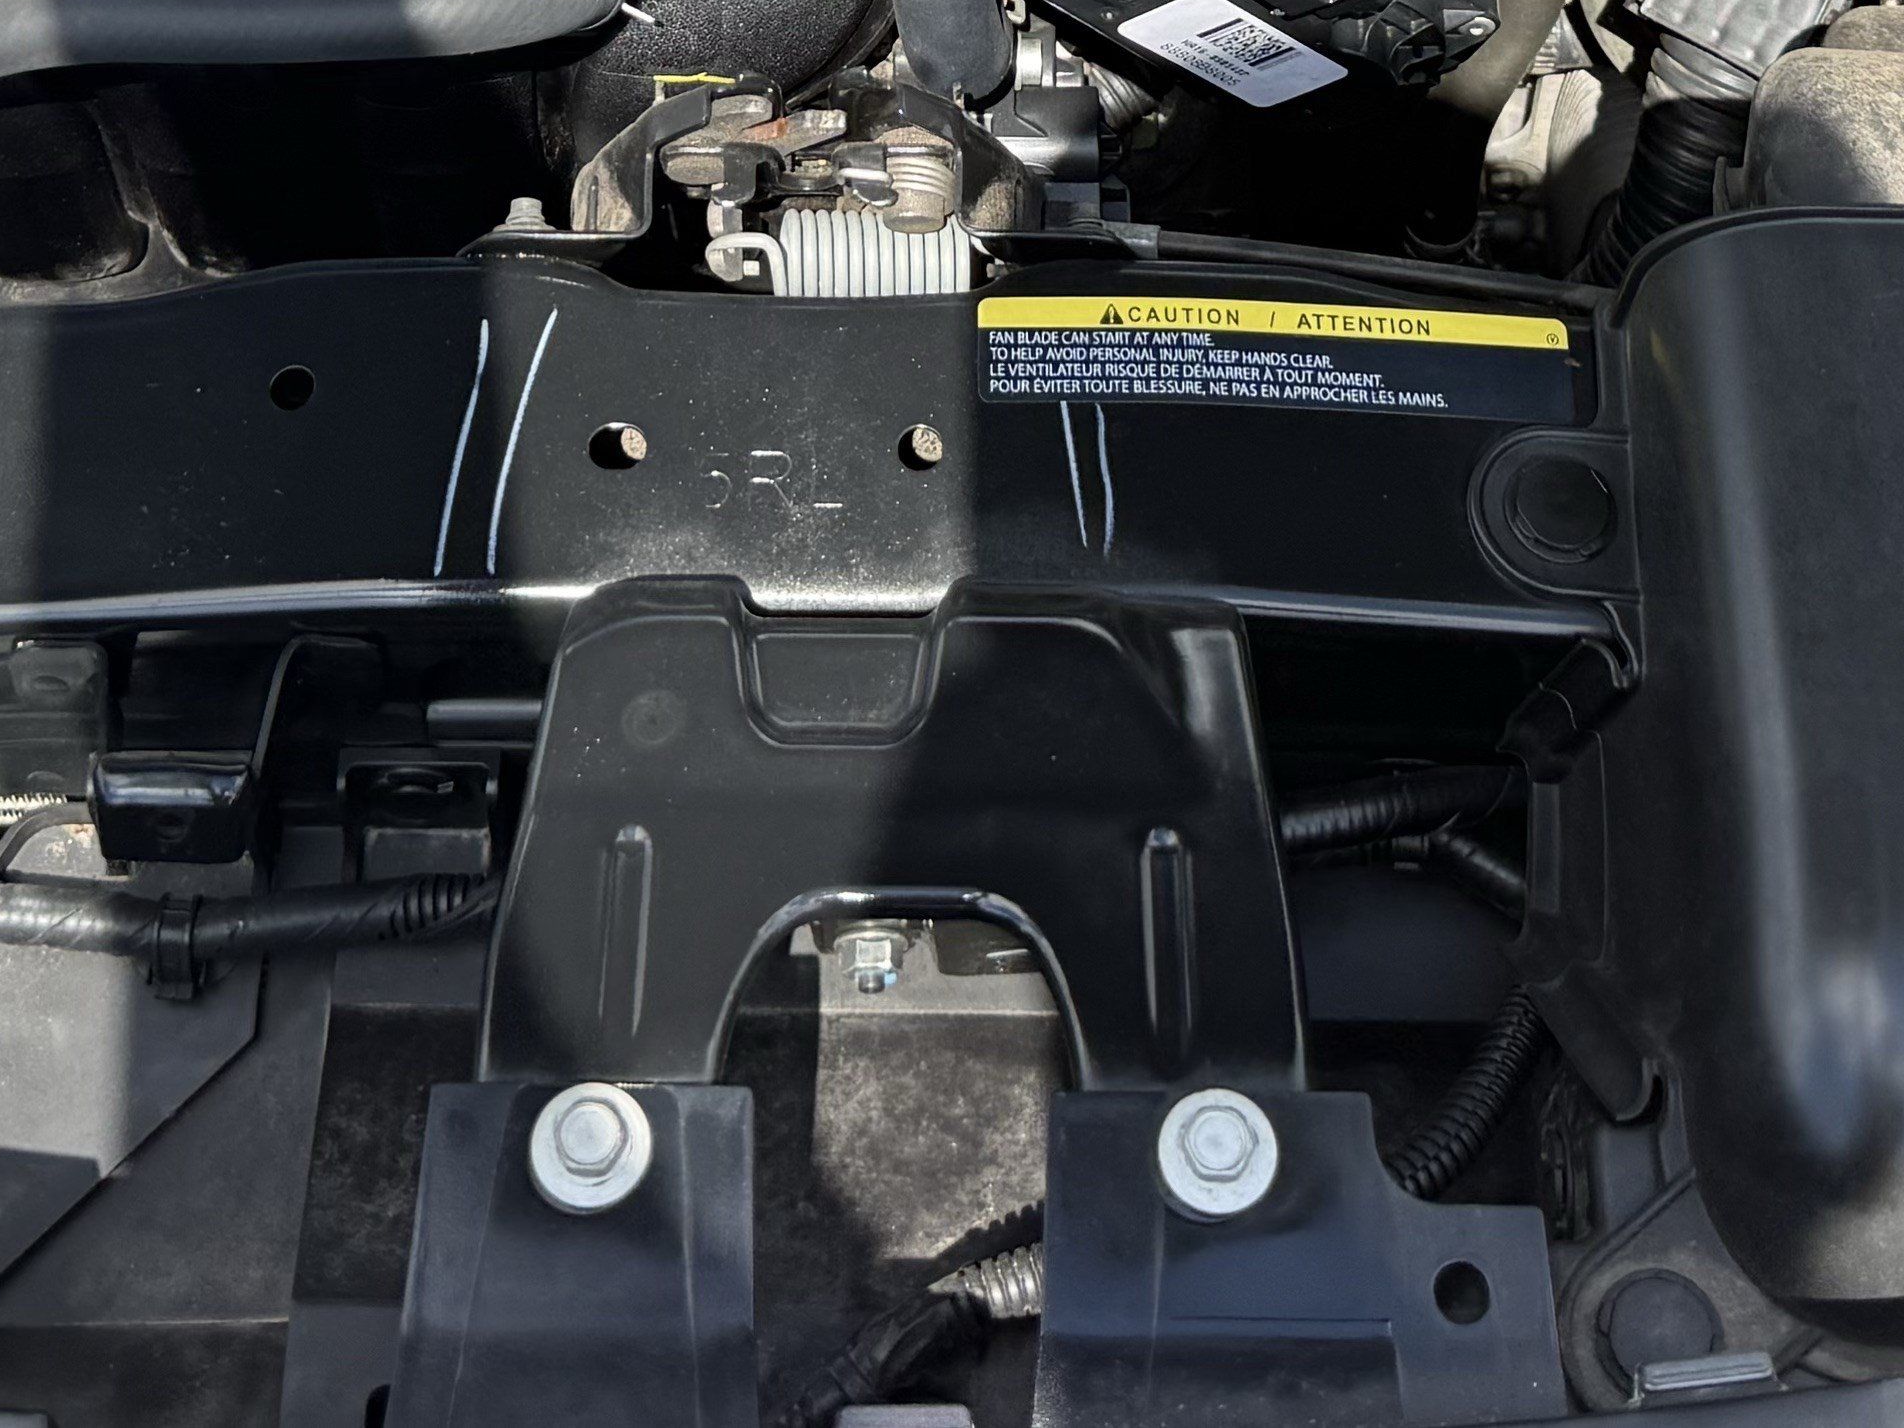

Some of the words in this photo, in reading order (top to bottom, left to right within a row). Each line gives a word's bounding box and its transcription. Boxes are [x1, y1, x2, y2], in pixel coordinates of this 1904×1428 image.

[1128, 306, 1239, 326] CAUTION
[1297, 313, 1431, 336] ATTENTION
[989, 331, 1014, 344] FAN
[1018, 331, 1059, 345] BLADE
[1062, 331, 1089, 344] CAN
[1133, 332, 1148, 344] AT
[1152, 332, 1179, 345] ANY
[1181, 332, 1215, 347] TIME.
[990, 347, 1008, 360] TO
[1011, 347, 1043, 361] HELP
[1046, 347, 1087, 361] AVOID
[1089, 347, 1156, 362] PERSONAL
[1208, 349, 1239, 363] KEEP
[1242, 350, 1288, 366] HANDS
[1290, 353, 1333, 369] CLEAR.
[990, 363, 1005, 376] LE
[1008, 363, 1102, 377] VENTILATEUR
[1105, 363, 1156, 378] RISQUE
[1160, 364, 1180, 377] DE
[1183, 363, 1260, 381] DÉMARRER
[1263, 366, 1274, 382] À
[1276, 369, 1314, 384] TOUT
[1317, 371, 1385, 388] MOMENT.
[990, 379, 1030, 393] POUR
[1034, 378, 1080, 393] ÉVITER
[1083, 380, 1129, 393] TOUTE
[1133, 380, 1206, 395] BLESSURE,
[1210, 382, 1229, 395] NE
[1232, 382, 1257, 397] PAS
[1261, 384, 1280, 398] EN
[1283, 385, 1369, 404] APPROCHER
[1372, 390, 1395, 405] LES
[1398, 391, 1448, 408] MAINS.
